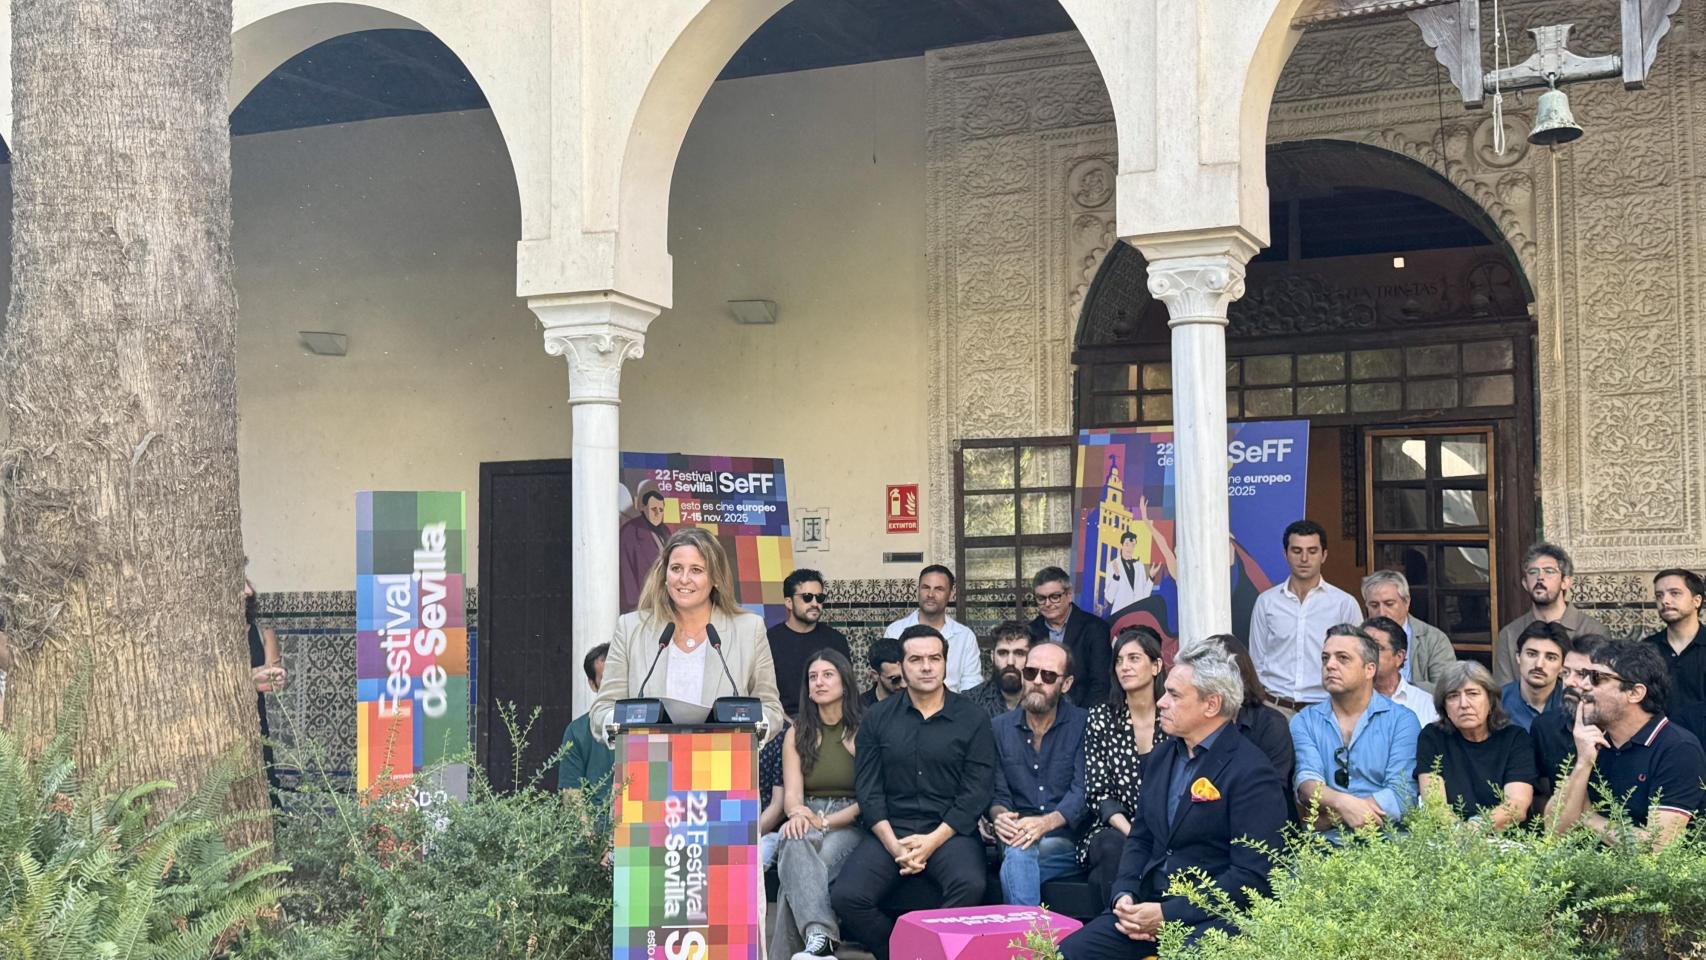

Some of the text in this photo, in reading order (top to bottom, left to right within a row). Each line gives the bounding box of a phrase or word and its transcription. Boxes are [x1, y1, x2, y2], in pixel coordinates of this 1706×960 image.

[1157, 443, 1173, 455] 22
[1228, 438, 1294, 464] SeFF
[1157, 455, 1173, 467] de
[655, 469, 714, 482] 22 Festival
[1243, 474, 1292, 485] europeo
[657, 481, 714, 493] de Sevilla
[719, 472, 774, 494] SeFF
[1228, 485, 1256, 496] 2025
[680, 502, 777, 513] esto es cine europeo
[681, 512, 749, 523] 7-15 nov. 2025
[412, 520, 448, 718] de Sevilla
[377, 574, 412, 720] Festival
[664, 795, 686, 919] de Sevilla
[686, 790, 708, 921] 22 Festival
[647, 930, 656, 956] esto
